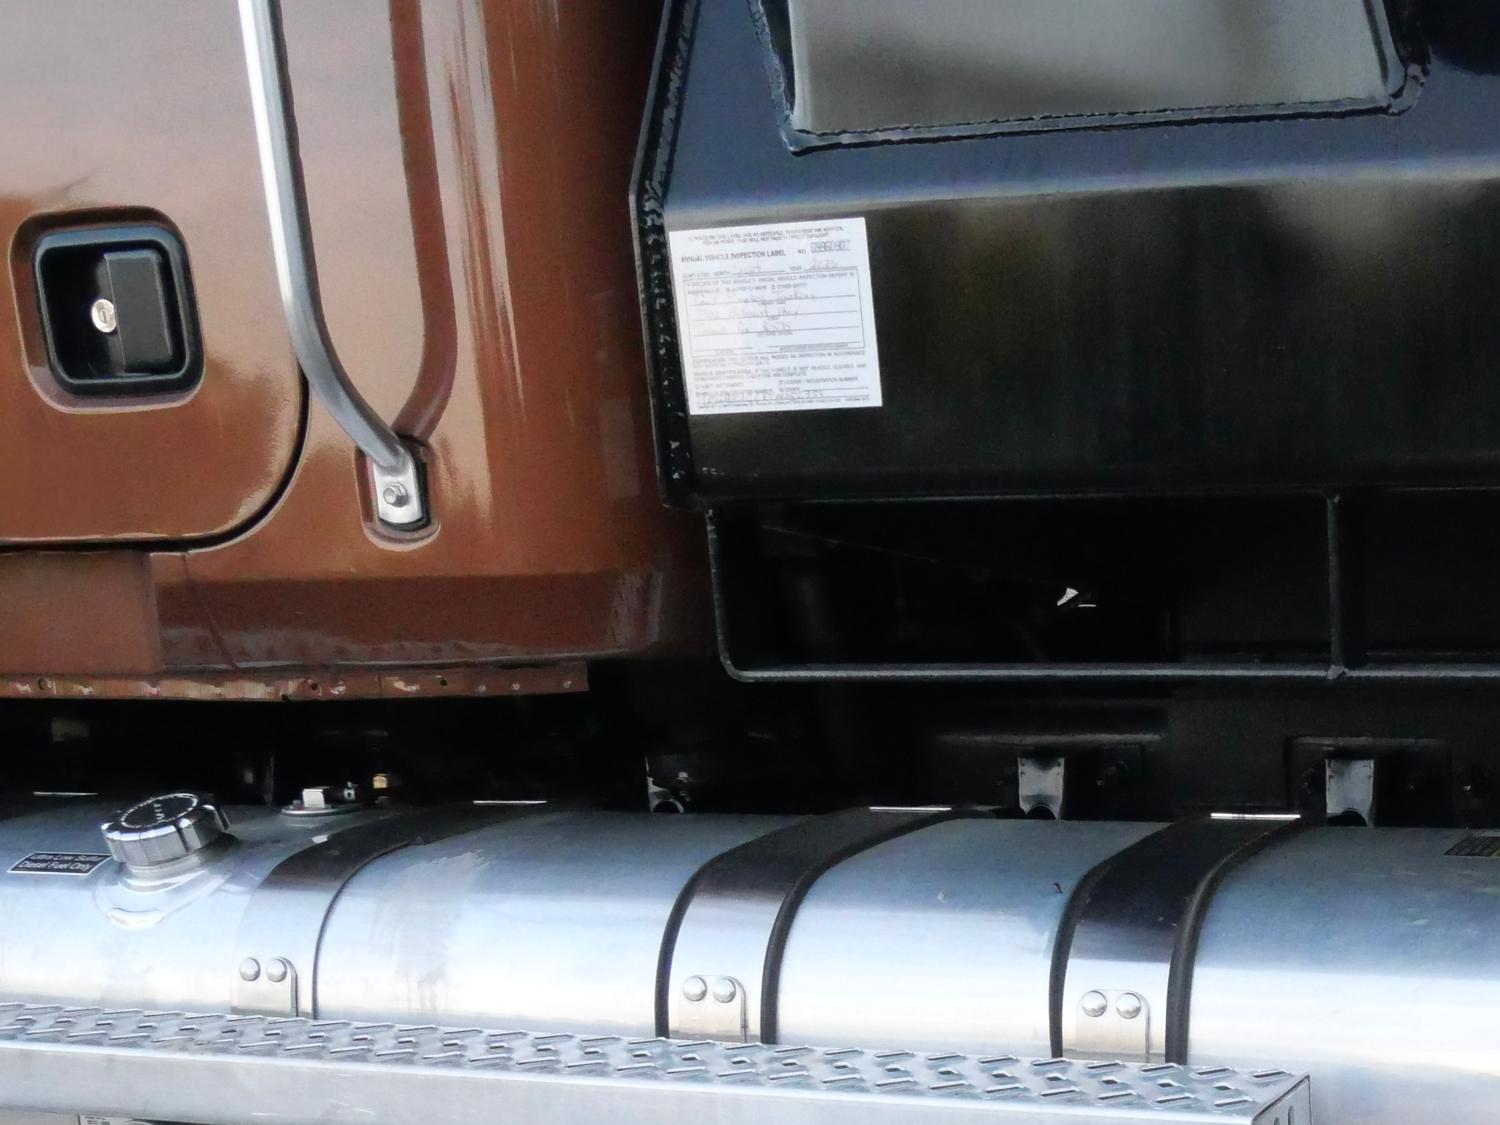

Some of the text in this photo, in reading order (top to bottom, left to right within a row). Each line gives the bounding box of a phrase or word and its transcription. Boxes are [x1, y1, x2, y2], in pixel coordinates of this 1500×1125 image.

[730, 250, 765, 260] INSPECTION
[766, 249, 787, 258] LABEL
[47, 861, 71, 870] Fuel
[69, 862, 92, 873] Only
